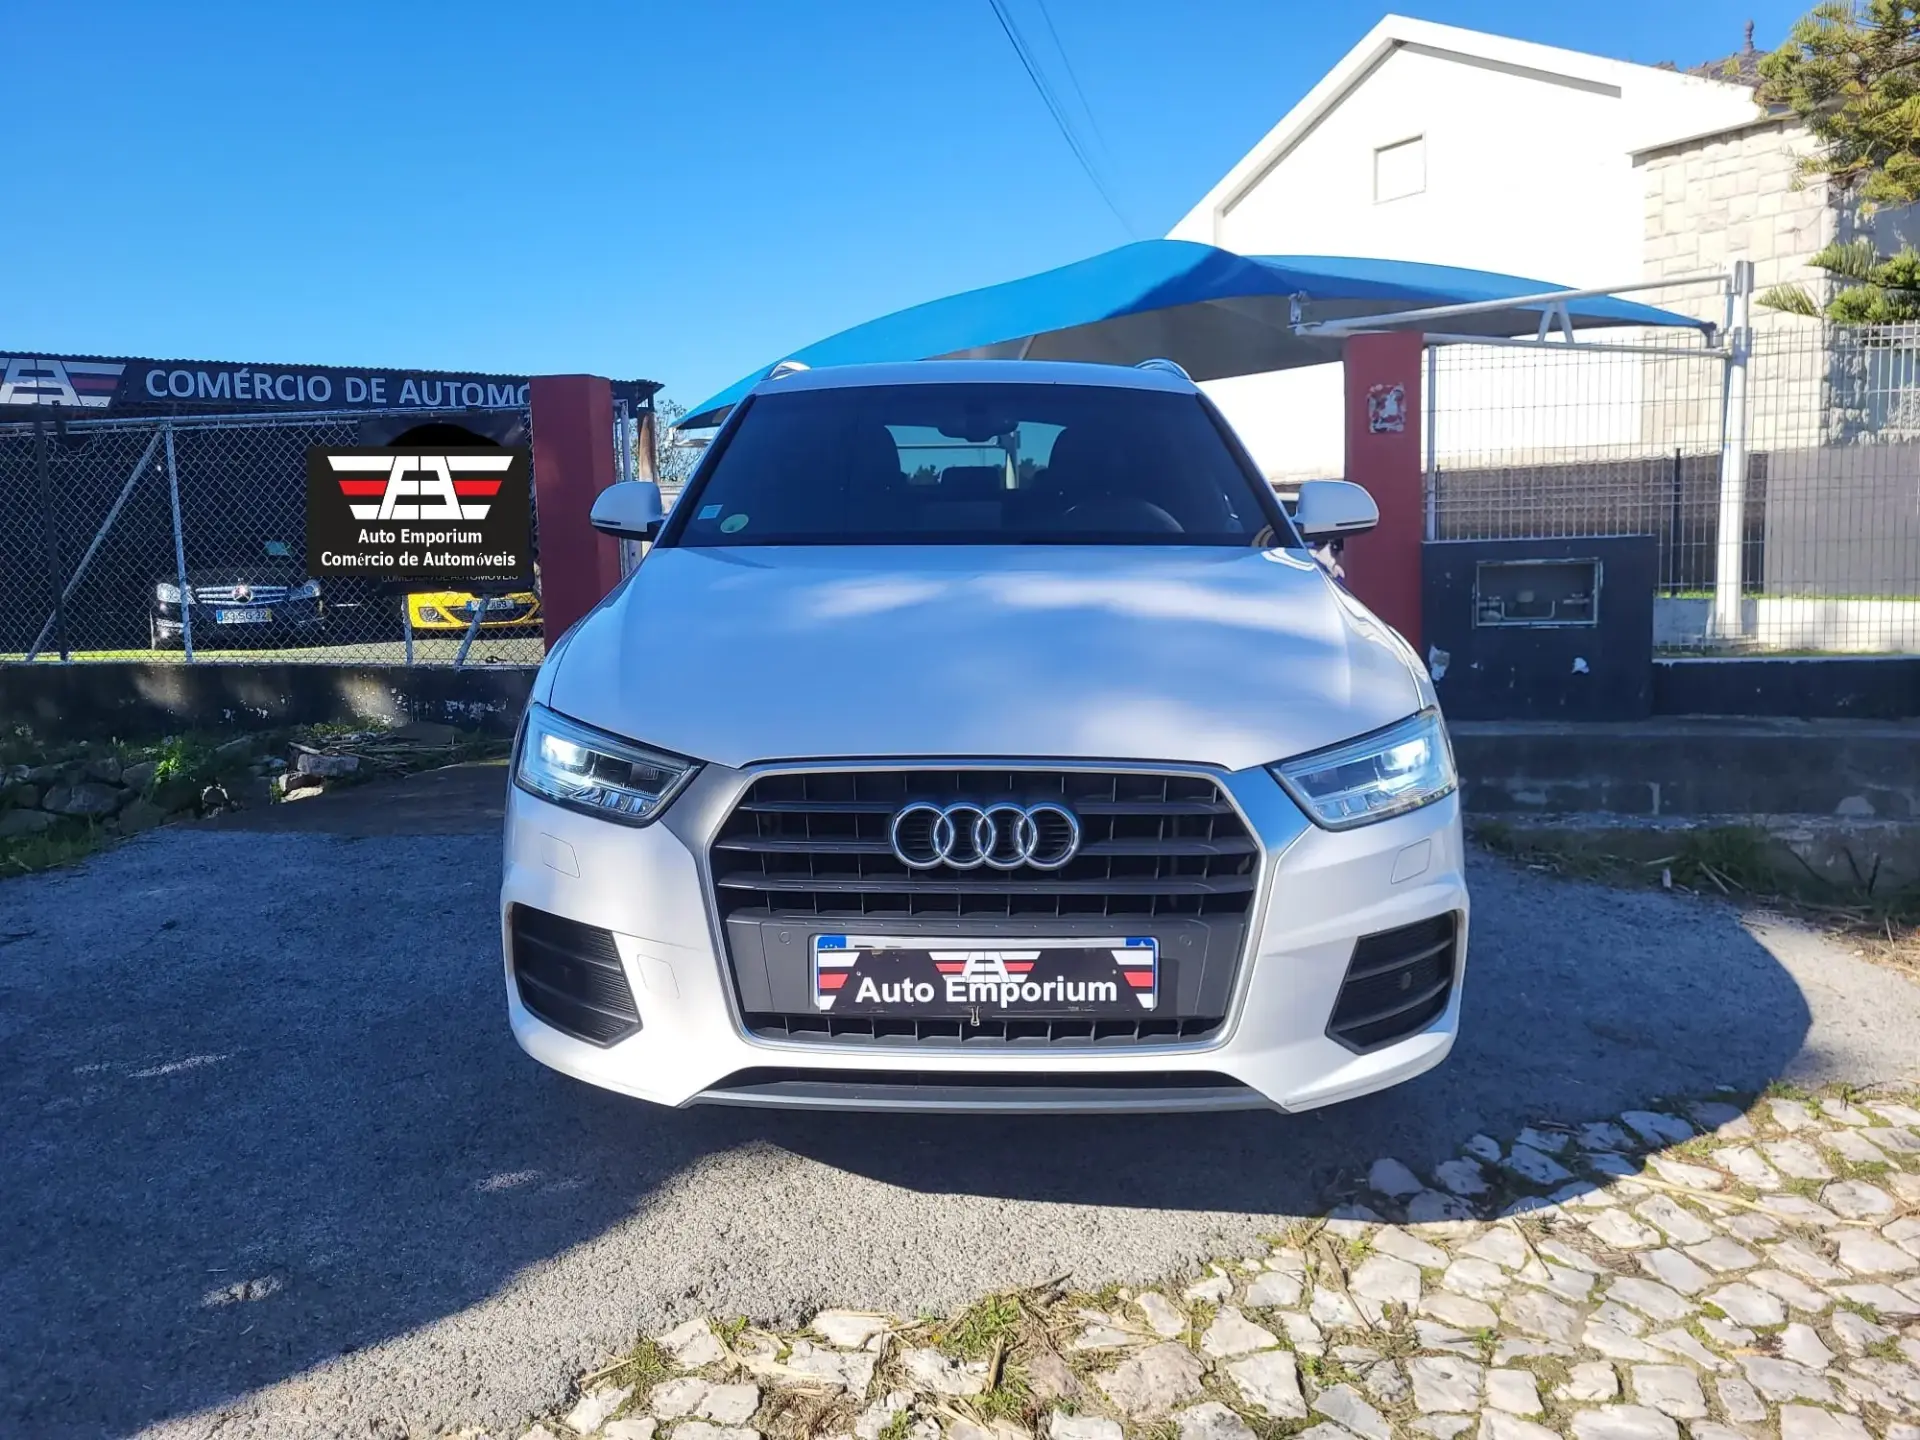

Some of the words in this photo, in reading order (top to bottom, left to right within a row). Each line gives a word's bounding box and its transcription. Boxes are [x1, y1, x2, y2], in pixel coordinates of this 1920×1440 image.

[145, 368, 332, 402] COMÉRCIO
[345, 376, 387, 403] DE
[855, 977, 935, 1003] Auto
[945, 975, 1117, 1009] Emporium
